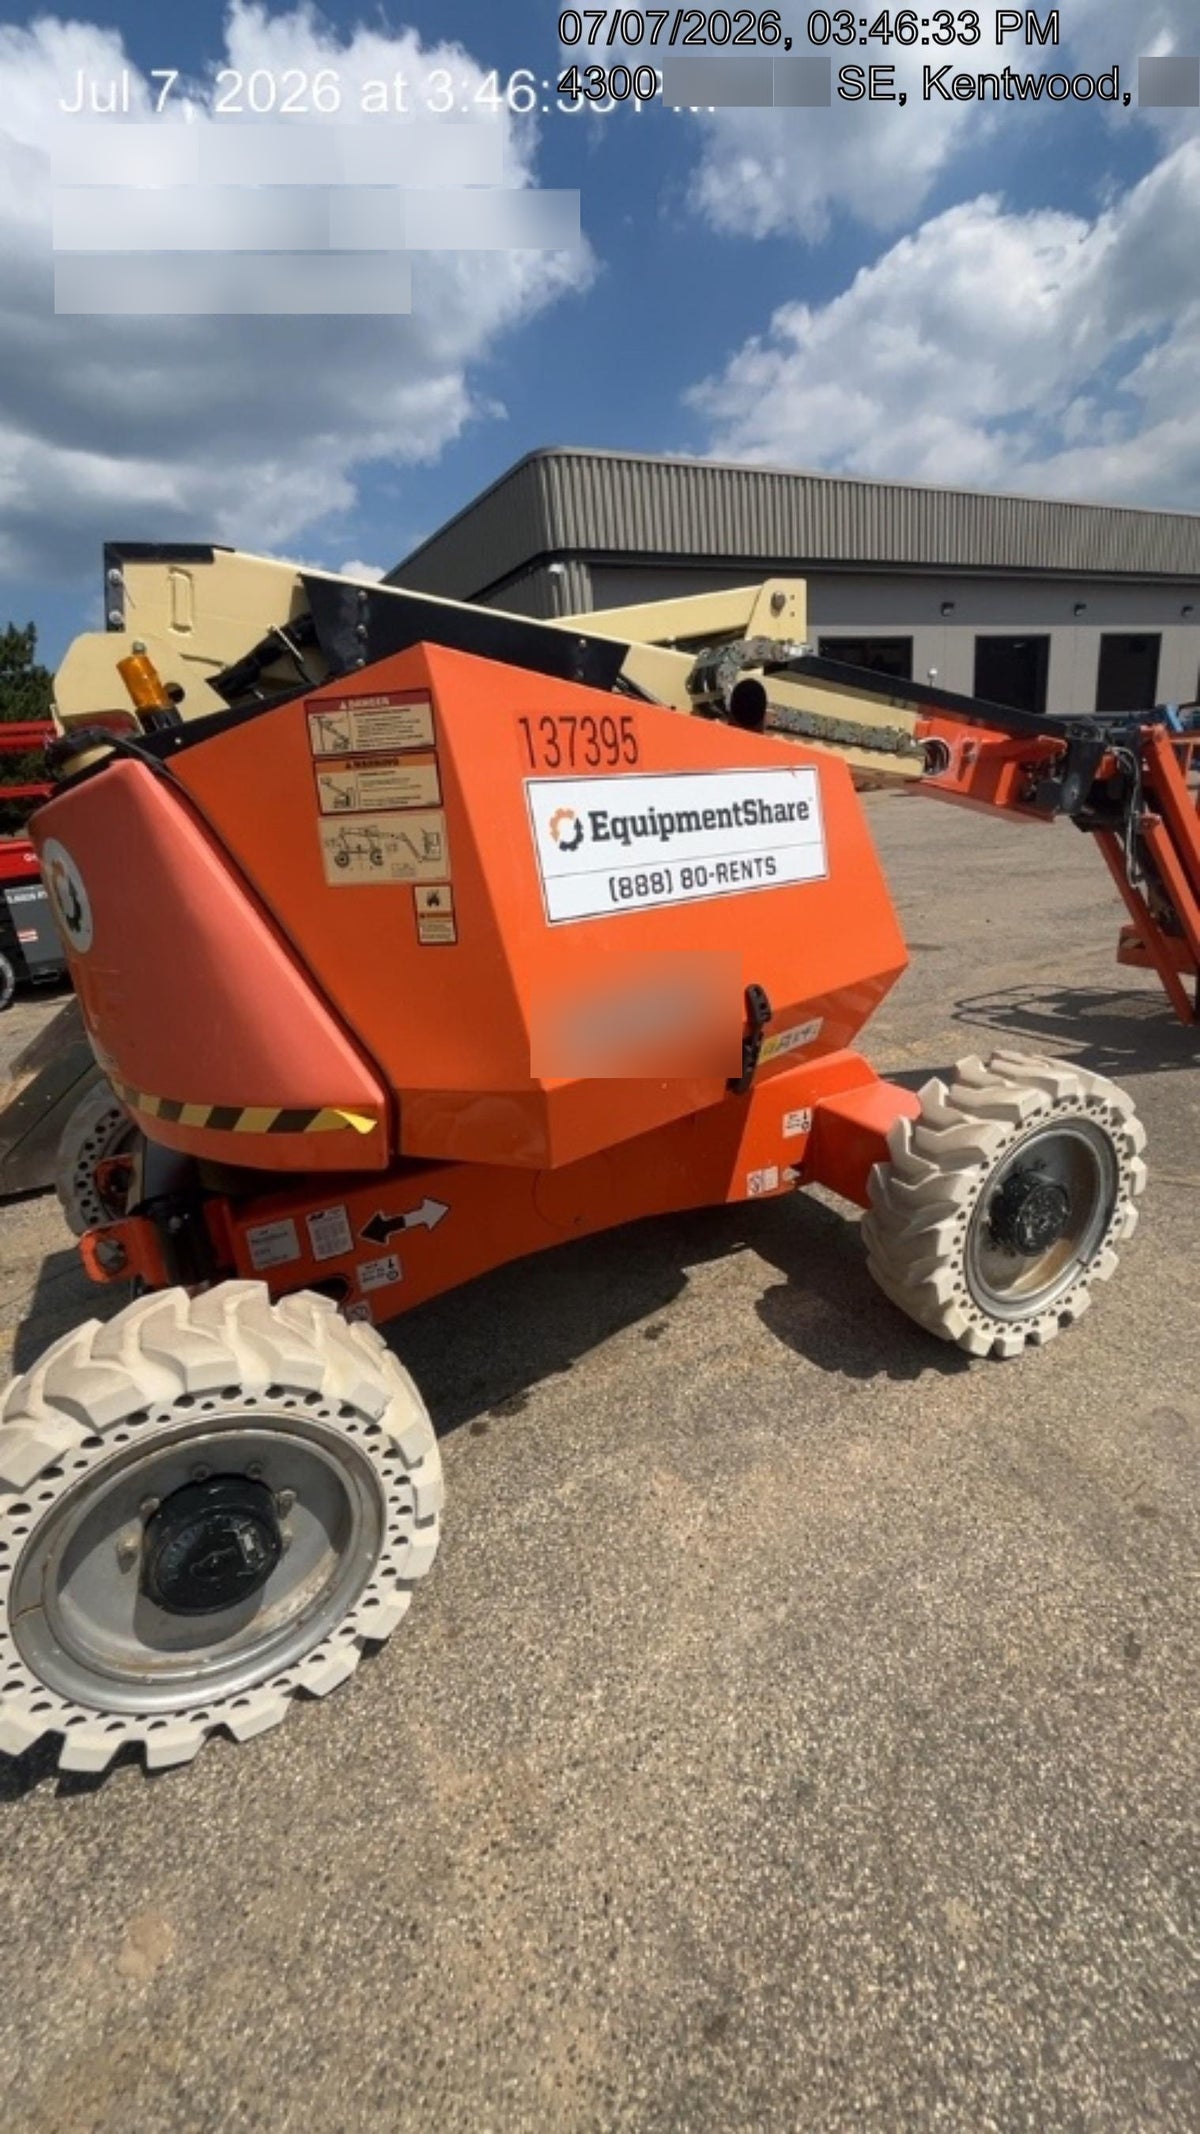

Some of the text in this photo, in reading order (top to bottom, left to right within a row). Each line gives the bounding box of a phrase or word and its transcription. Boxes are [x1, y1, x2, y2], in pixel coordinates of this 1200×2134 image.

[518, 716, 638, 769] 137395
[588, 797, 810, 846] EquipmentShare
[609, 856, 778, 902] (888) 80-RENTS
